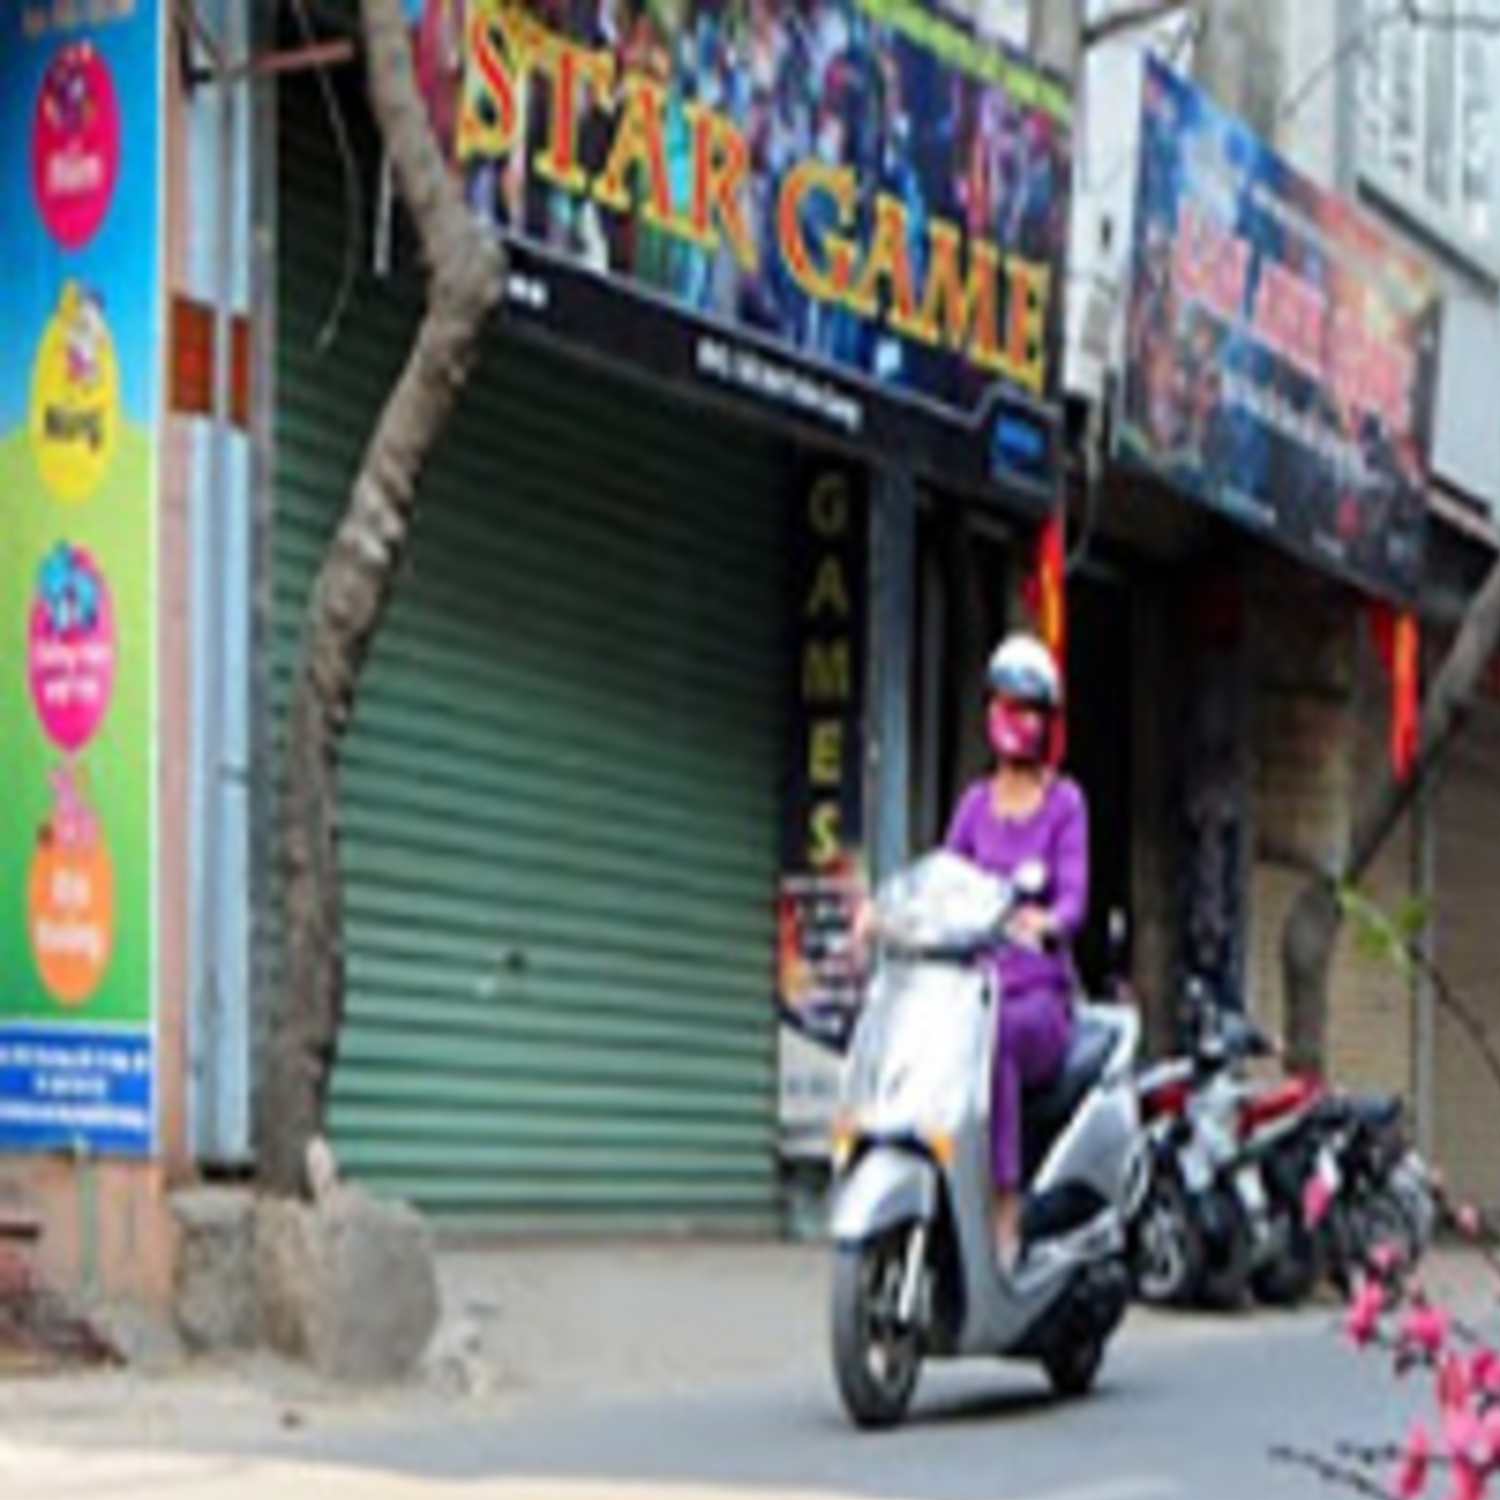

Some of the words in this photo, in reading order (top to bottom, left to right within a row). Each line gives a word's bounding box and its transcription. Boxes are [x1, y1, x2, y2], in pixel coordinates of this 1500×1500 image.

[456, 0, 759, 275] STAR
[778, 158, 1051, 400] GAME
[806, 472, 851, 866] GAMES
